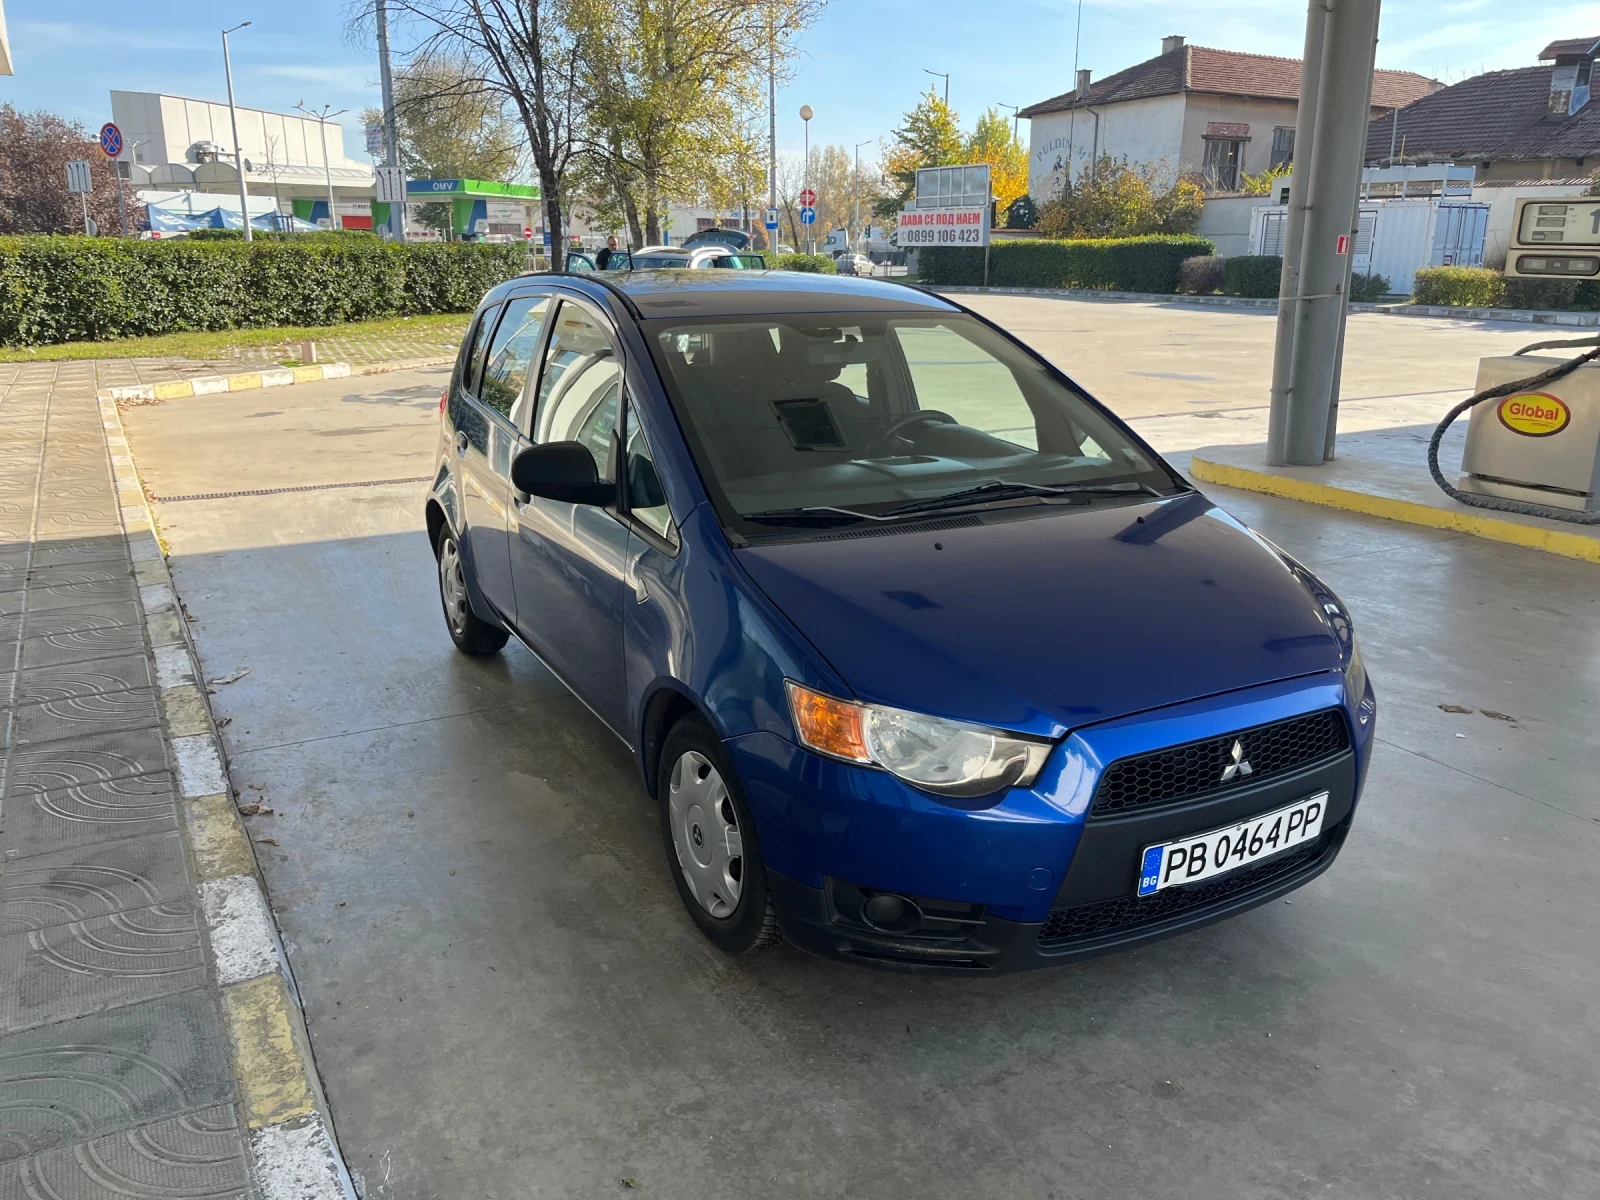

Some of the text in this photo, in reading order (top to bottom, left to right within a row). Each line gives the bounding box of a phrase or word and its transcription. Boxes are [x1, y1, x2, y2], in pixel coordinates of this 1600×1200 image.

[432, 182, 453, 191] OMV
[900, 212, 981, 227] ДАВА СЕ ПОД НАЕМ
[907, 228, 980, 243] 0899 106 423
[1508, 402, 1560, 421] Global
[1163, 802, 1322, 883] PB 0464 PP
[1142, 875, 1157, 888] BG
